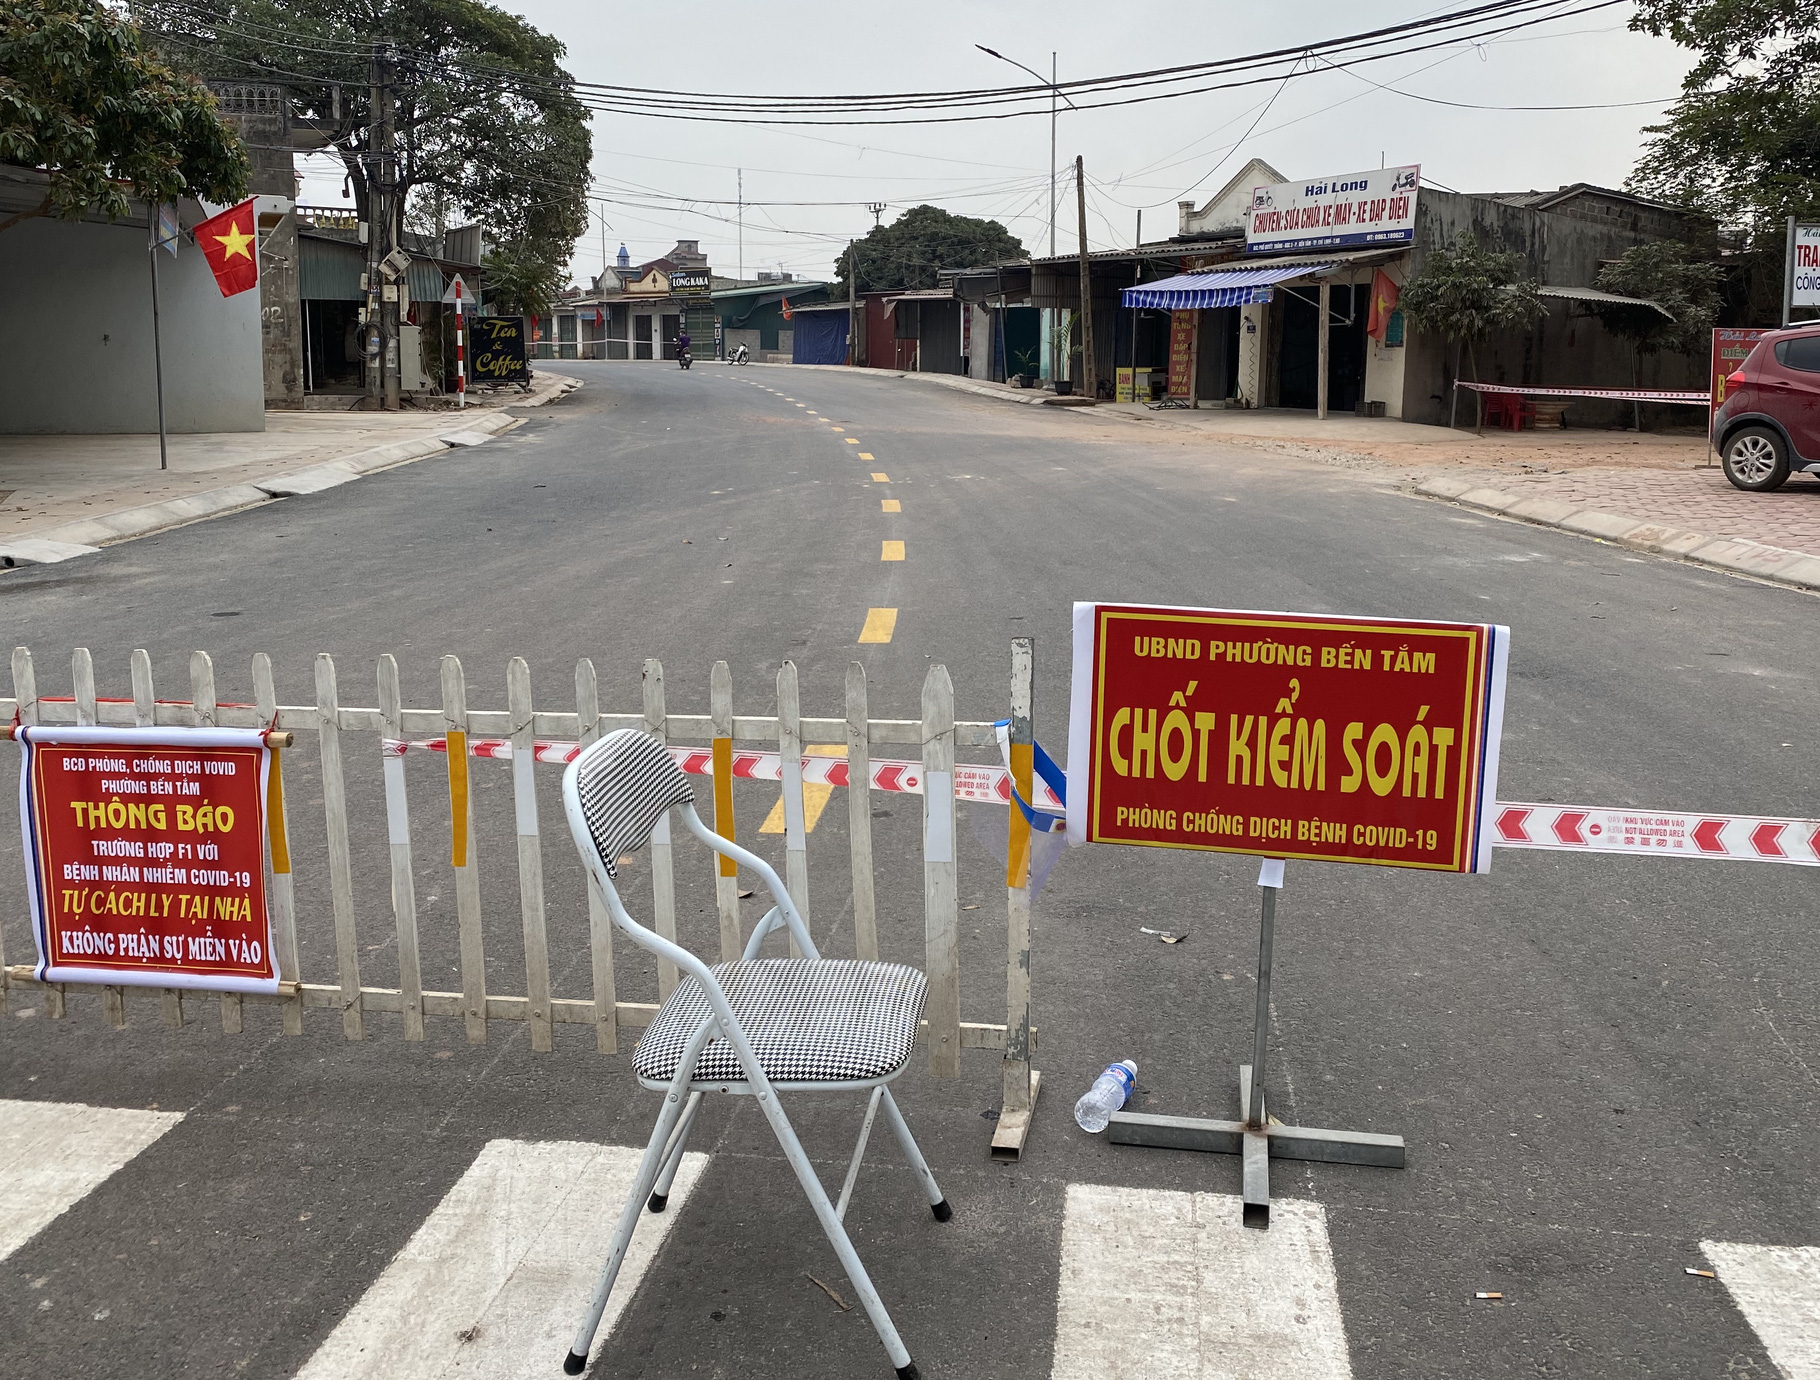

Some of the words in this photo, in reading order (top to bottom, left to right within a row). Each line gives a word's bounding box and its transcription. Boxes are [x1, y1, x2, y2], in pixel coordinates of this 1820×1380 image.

[1331, 179, 1368, 194] Long
[1321, 205, 1333, 227] XE
[1369, 199, 1386, 226] ĐẠP
[1797, 244, 1820, 272] TRẠ
[672, 277, 690, 287] LONG
[690, 276, 709, 286] KAKA
[482, 319, 518, 339] Tea
[476, 353, 523, 376] Coffee
[1134, 636, 1201, 660] UBND
[1209, 637, 1312, 667] PHƯỜNG
[1321, 641, 1372, 670] BẾN
[1381, 643, 1436, 674] TẮM
[1109, 680, 1216, 783] CHỐT
[1227, 677, 1327, 791] KIỂM
[1340, 705, 1455, 799] SOÁT
[63, 757, 85, 771] BCĐ
[88, 756, 130, 774] PHÒNG,
[133, 755, 172, 773] CHỐNG
[175, 761, 201, 777] DỊCH
[204, 761, 236, 776] VOVID
[101, 776, 147, 794] PHƯỜNG
[150, 777, 173, 795] BẾN
[176, 778, 200, 795] TẮM
[70, 796, 167, 831] THÔNG
[176, 799, 235, 834] BÁO
[1116, 803, 1177, 831] PHÒNG
[1182, 806, 1244, 836] CHỐNG
[1249, 816, 1292, 842] DỊCH
[1297, 816, 1347, 846] BỆNH
[1353, 824, 1438, 851] COVID-19
[1638, 827, 1668, 837] ALLOWED
[1668, 829, 1685, 838] AREA
[91, 837, 144, 858] TRƯỜNG
[148, 842, 174, 862] HỢP
[178, 843, 192, 860] F1
[197, 840, 219, 861] VỚI
[63, 861, 99, 884] BỆNH
[102, 863, 140, 882] NHÂN
[143, 862, 187, 884] NHIỄM
[190, 869, 251, 888] COVID-19
[62, 886, 89, 920] TỰ
[90, 885, 146, 916] CÁCH
[150, 893, 173, 917] LY
[178, 894, 209, 925] TẠI
[213, 893, 252, 922] NHÀ
[61, 924, 115, 956] KHÔNG
[118, 927, 160, 963] PHẬN
[163, 934, 185, 965] SỰ
[187, 925, 226, 961] MIỄN
[228, 932, 262, 964] VÀO
